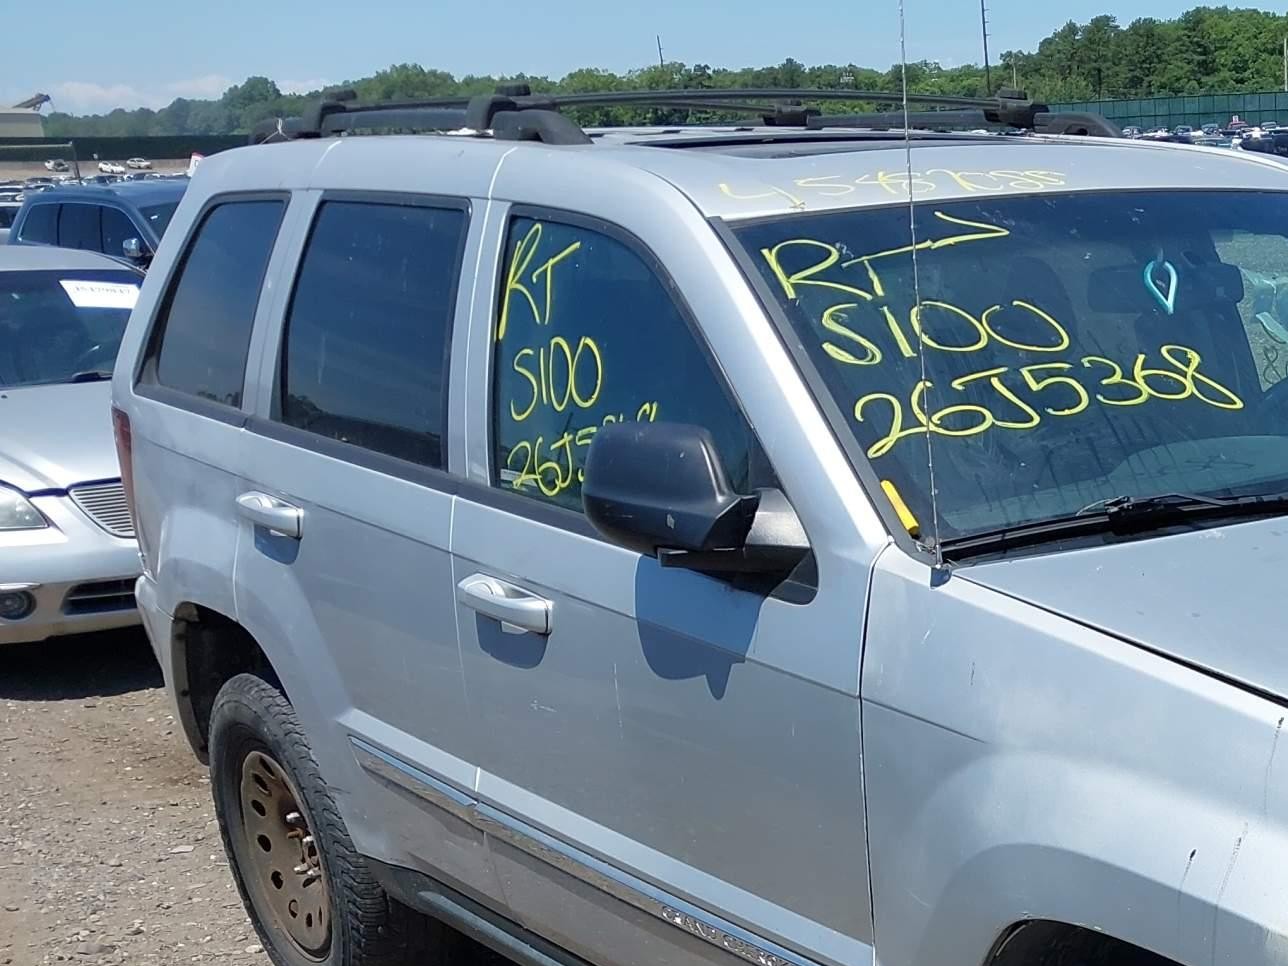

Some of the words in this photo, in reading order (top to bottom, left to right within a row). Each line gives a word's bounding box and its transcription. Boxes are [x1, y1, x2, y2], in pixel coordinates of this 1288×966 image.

[494, 222, 582, 342] RT
[762, 239, 932, 301] RT
[821, 300, 1070, 366] S100
[510, 336, 603, 421] S100
[854, 344, 1245, 459] 26J5368
